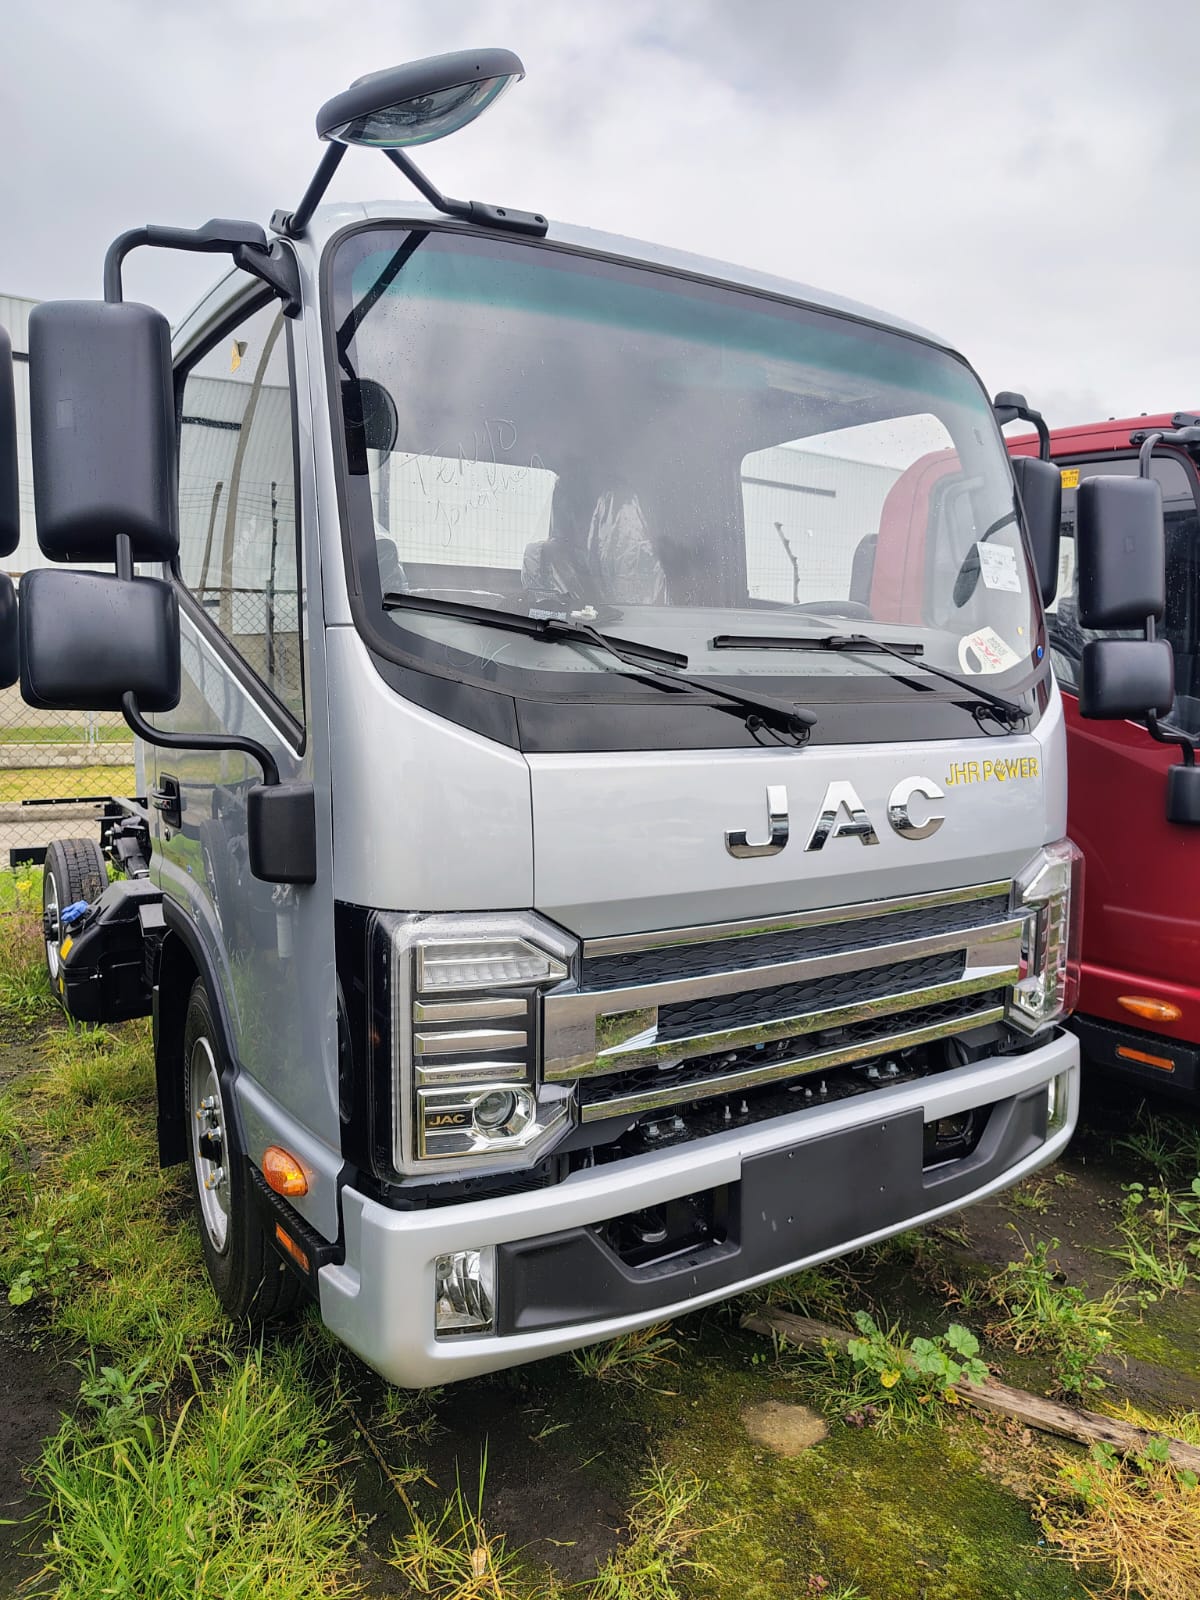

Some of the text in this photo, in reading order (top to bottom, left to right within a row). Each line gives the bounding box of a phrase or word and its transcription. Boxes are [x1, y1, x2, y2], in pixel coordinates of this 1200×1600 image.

[945, 761, 981, 786] JHR
[724, 775, 946, 860] JAC
[429, 1113, 467, 1126] JAC
